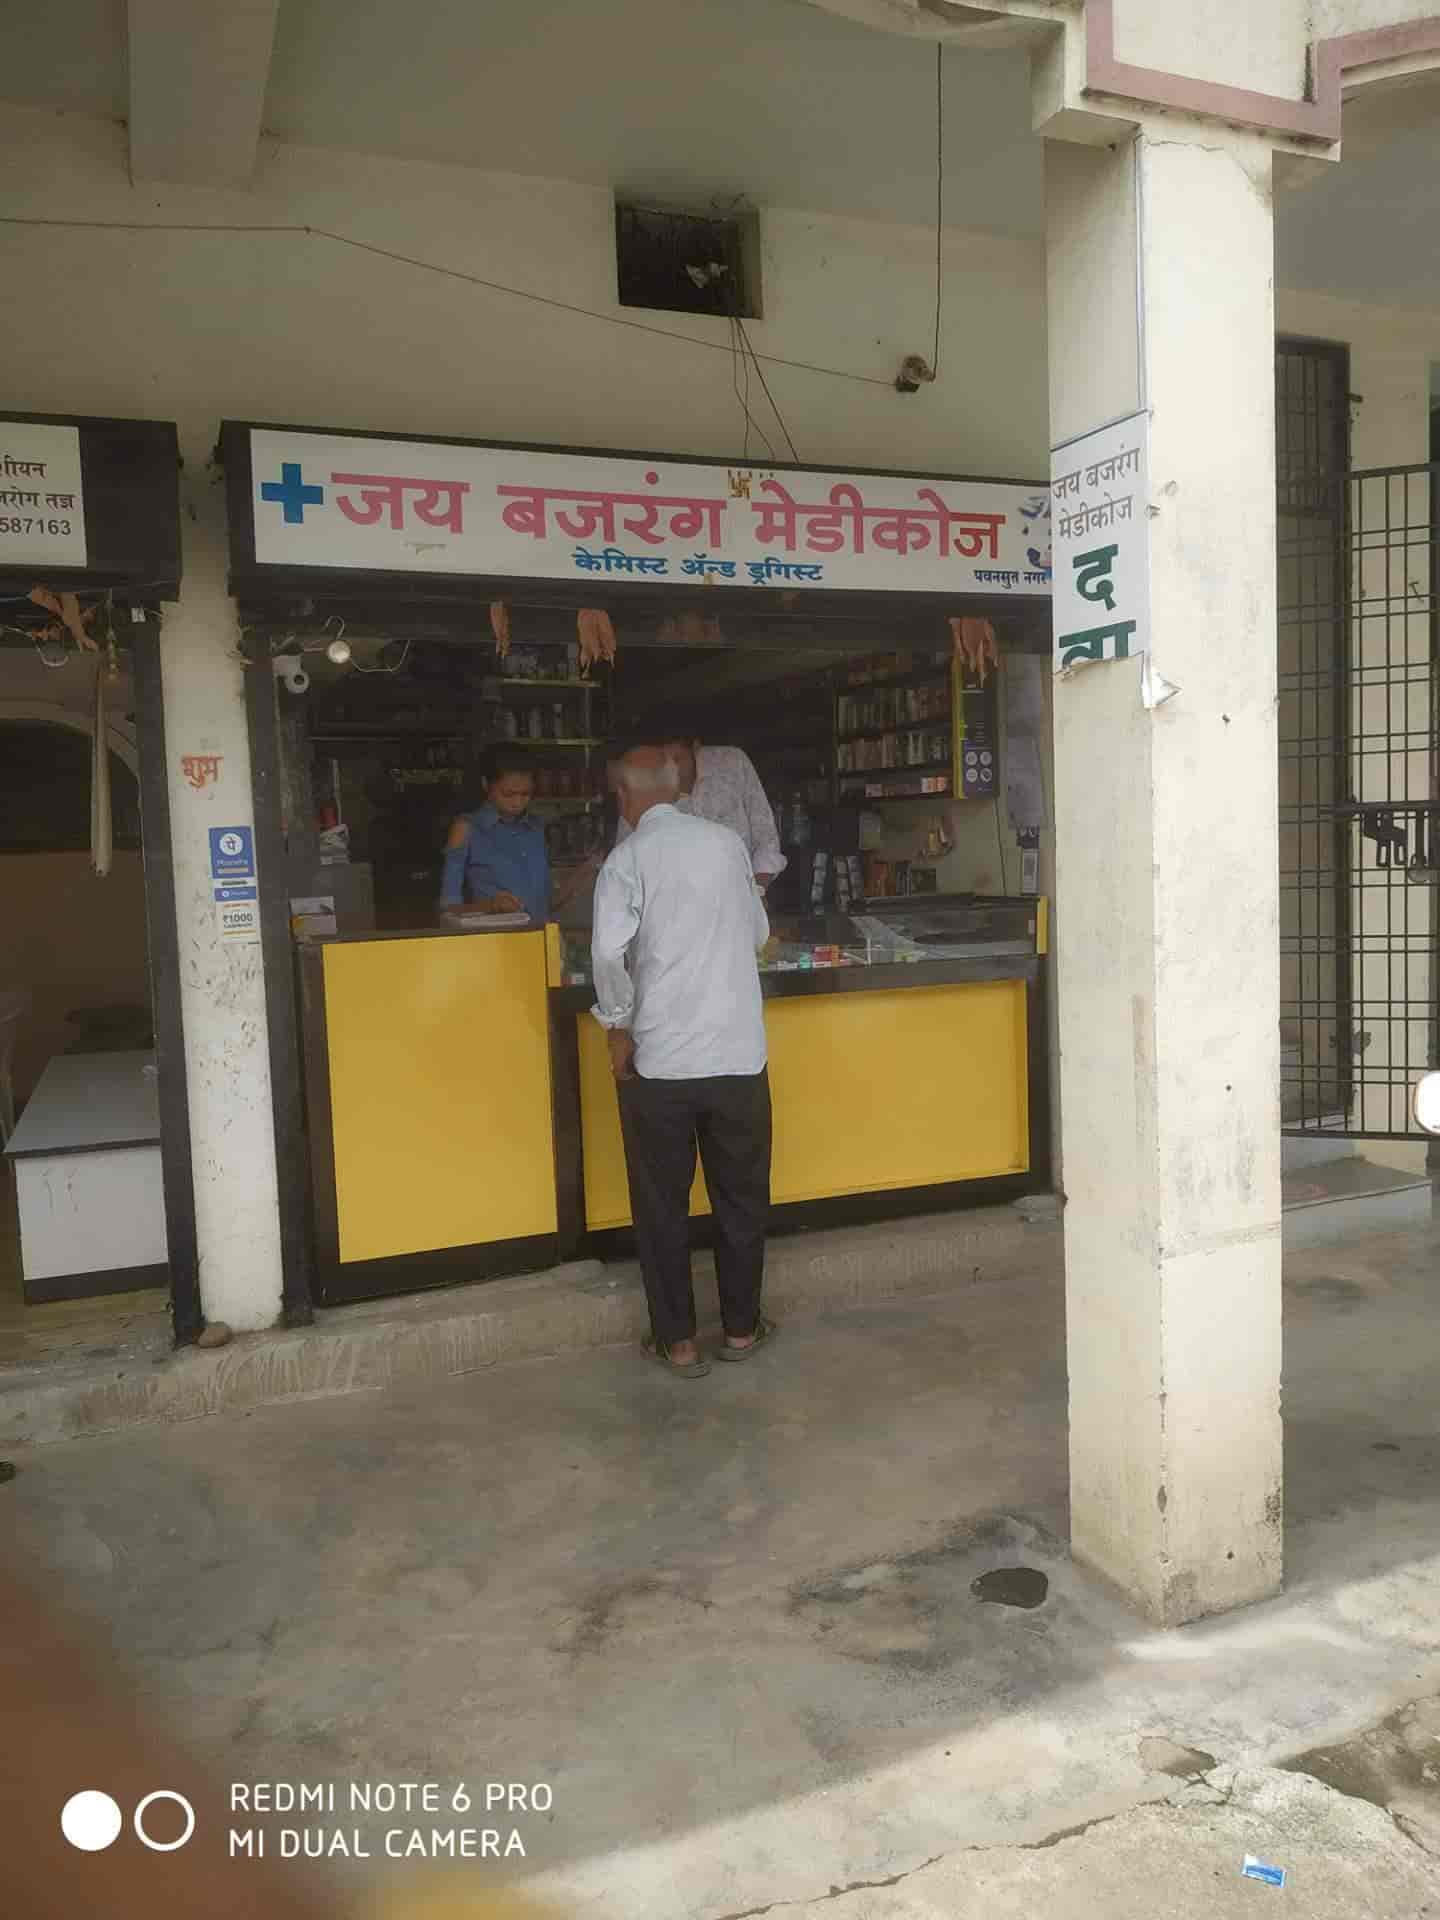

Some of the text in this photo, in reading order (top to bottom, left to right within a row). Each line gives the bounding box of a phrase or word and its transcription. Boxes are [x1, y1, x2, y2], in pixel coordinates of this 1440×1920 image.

[1051, 443, 1140, 499] जय बजरंग
[0, 517, 71, 536] 587163
[331, 471, 1006, 559] जय बजरंग मेडीकोज
[1058, 491, 1133, 539] मेडीकोज
[571, 546, 669, 575] केमिस्ट
[744, 556, 823, 585] ड्रगिस्ट
